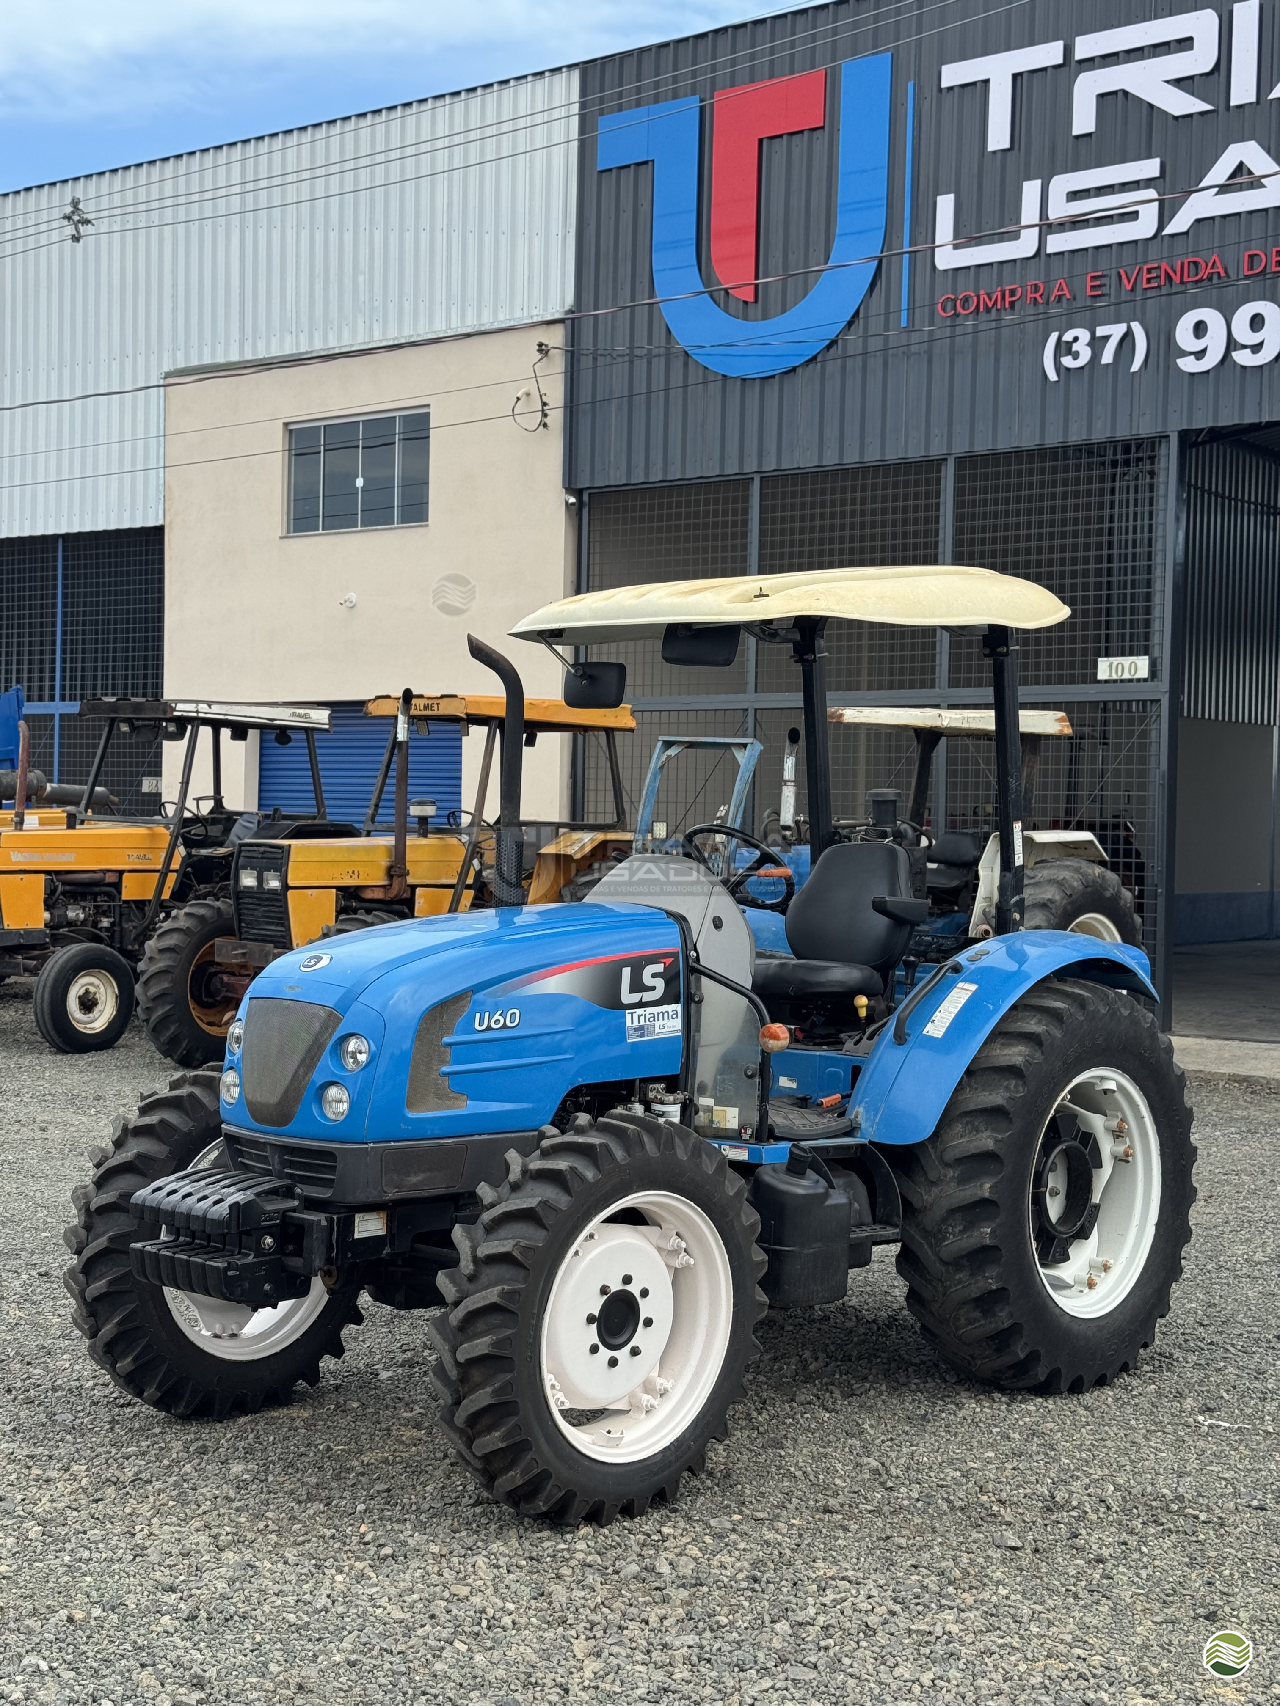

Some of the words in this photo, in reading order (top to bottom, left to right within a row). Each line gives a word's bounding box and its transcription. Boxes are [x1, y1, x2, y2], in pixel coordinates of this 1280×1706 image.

[940, 0, 1280, 152] TRI
[937, 278, 1071, 318] COMPRA
[1086, 271, 1104, 296] E
[1120, 254, 1227, 292] VENDA
[1243, 247, 1280, 276] DE
[1042, 321, 1148, 382] (37)
[1175, 300, 1280, 374] 99
[1107, 660, 1138, 678] 100
[620, 962, 666, 1005] LS
[474, 1008, 520, 1032] U60
[626, 1008, 680, 1026] Triama
